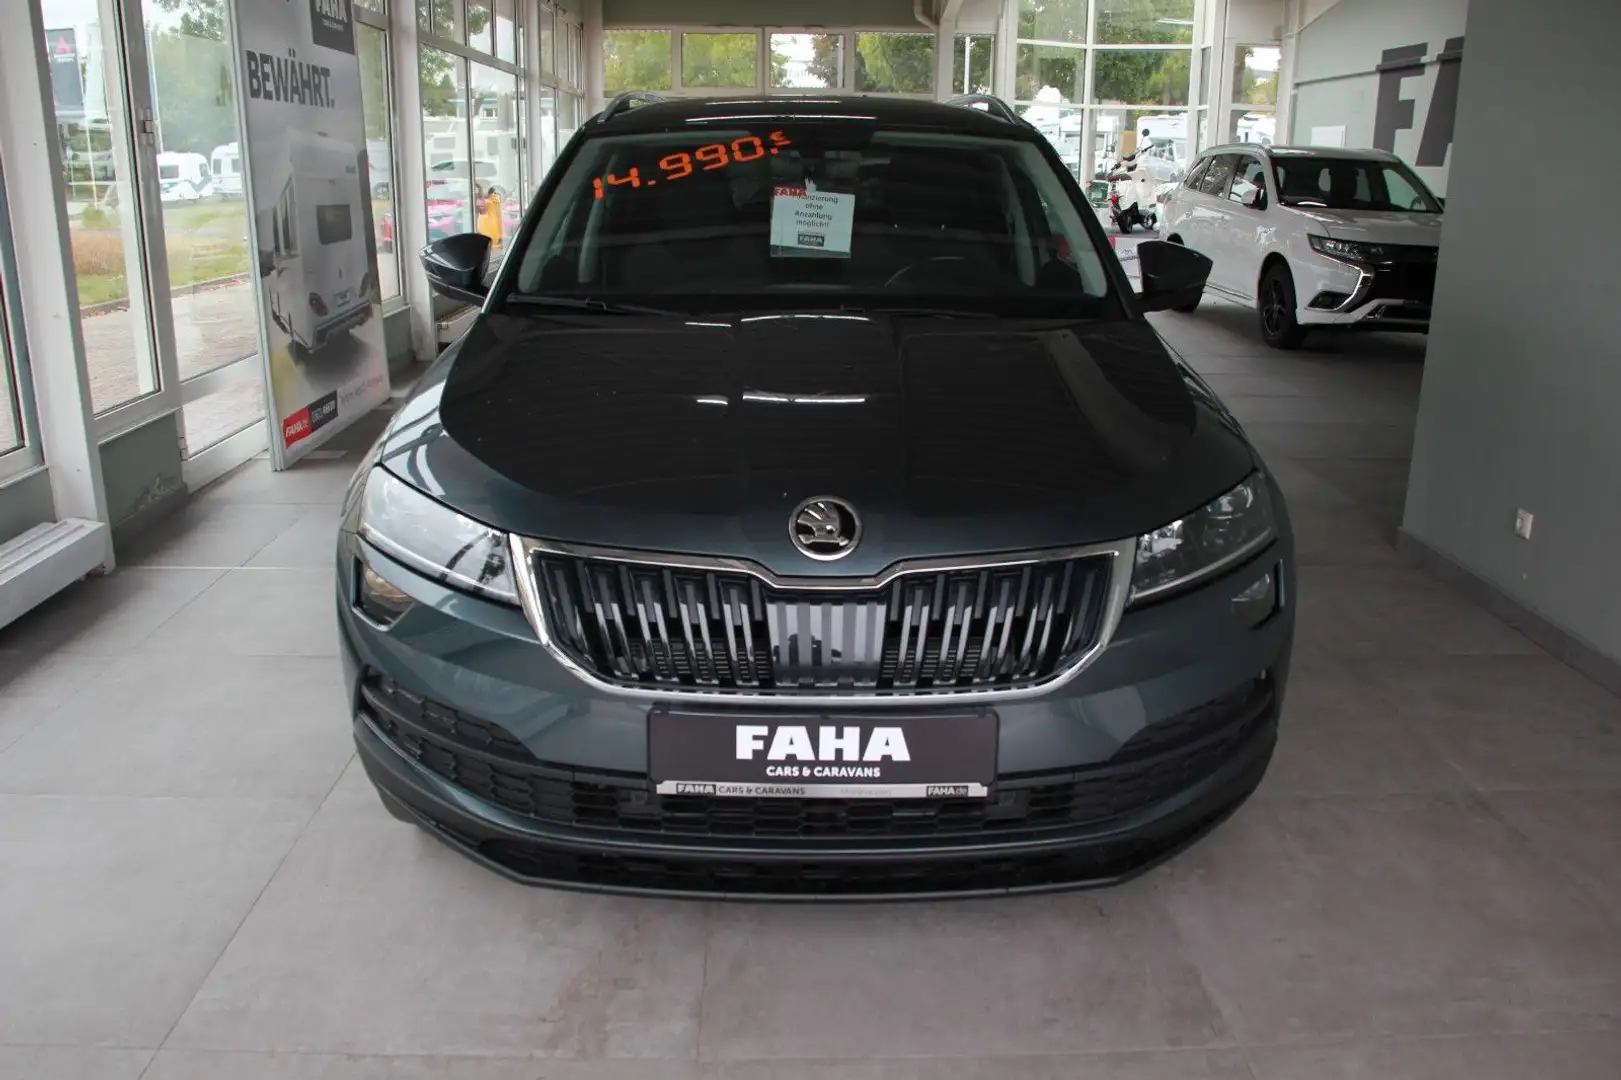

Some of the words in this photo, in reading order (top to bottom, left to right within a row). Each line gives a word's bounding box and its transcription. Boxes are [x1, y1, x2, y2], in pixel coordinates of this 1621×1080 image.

[247, 48, 335, 109] BEWÄHRT.
[735, 725, 911, 761] FAHA
[766, 765, 800, 777] CARS
[802, 766, 811, 777] &
[813, 766, 881, 778] CARAVANS
[678, 783, 715, 794] FAHA
[718, 785, 743, 795] CARS
[754, 786, 806, 796] CARAVANS
[927, 786, 968, 797] FAHA.de
